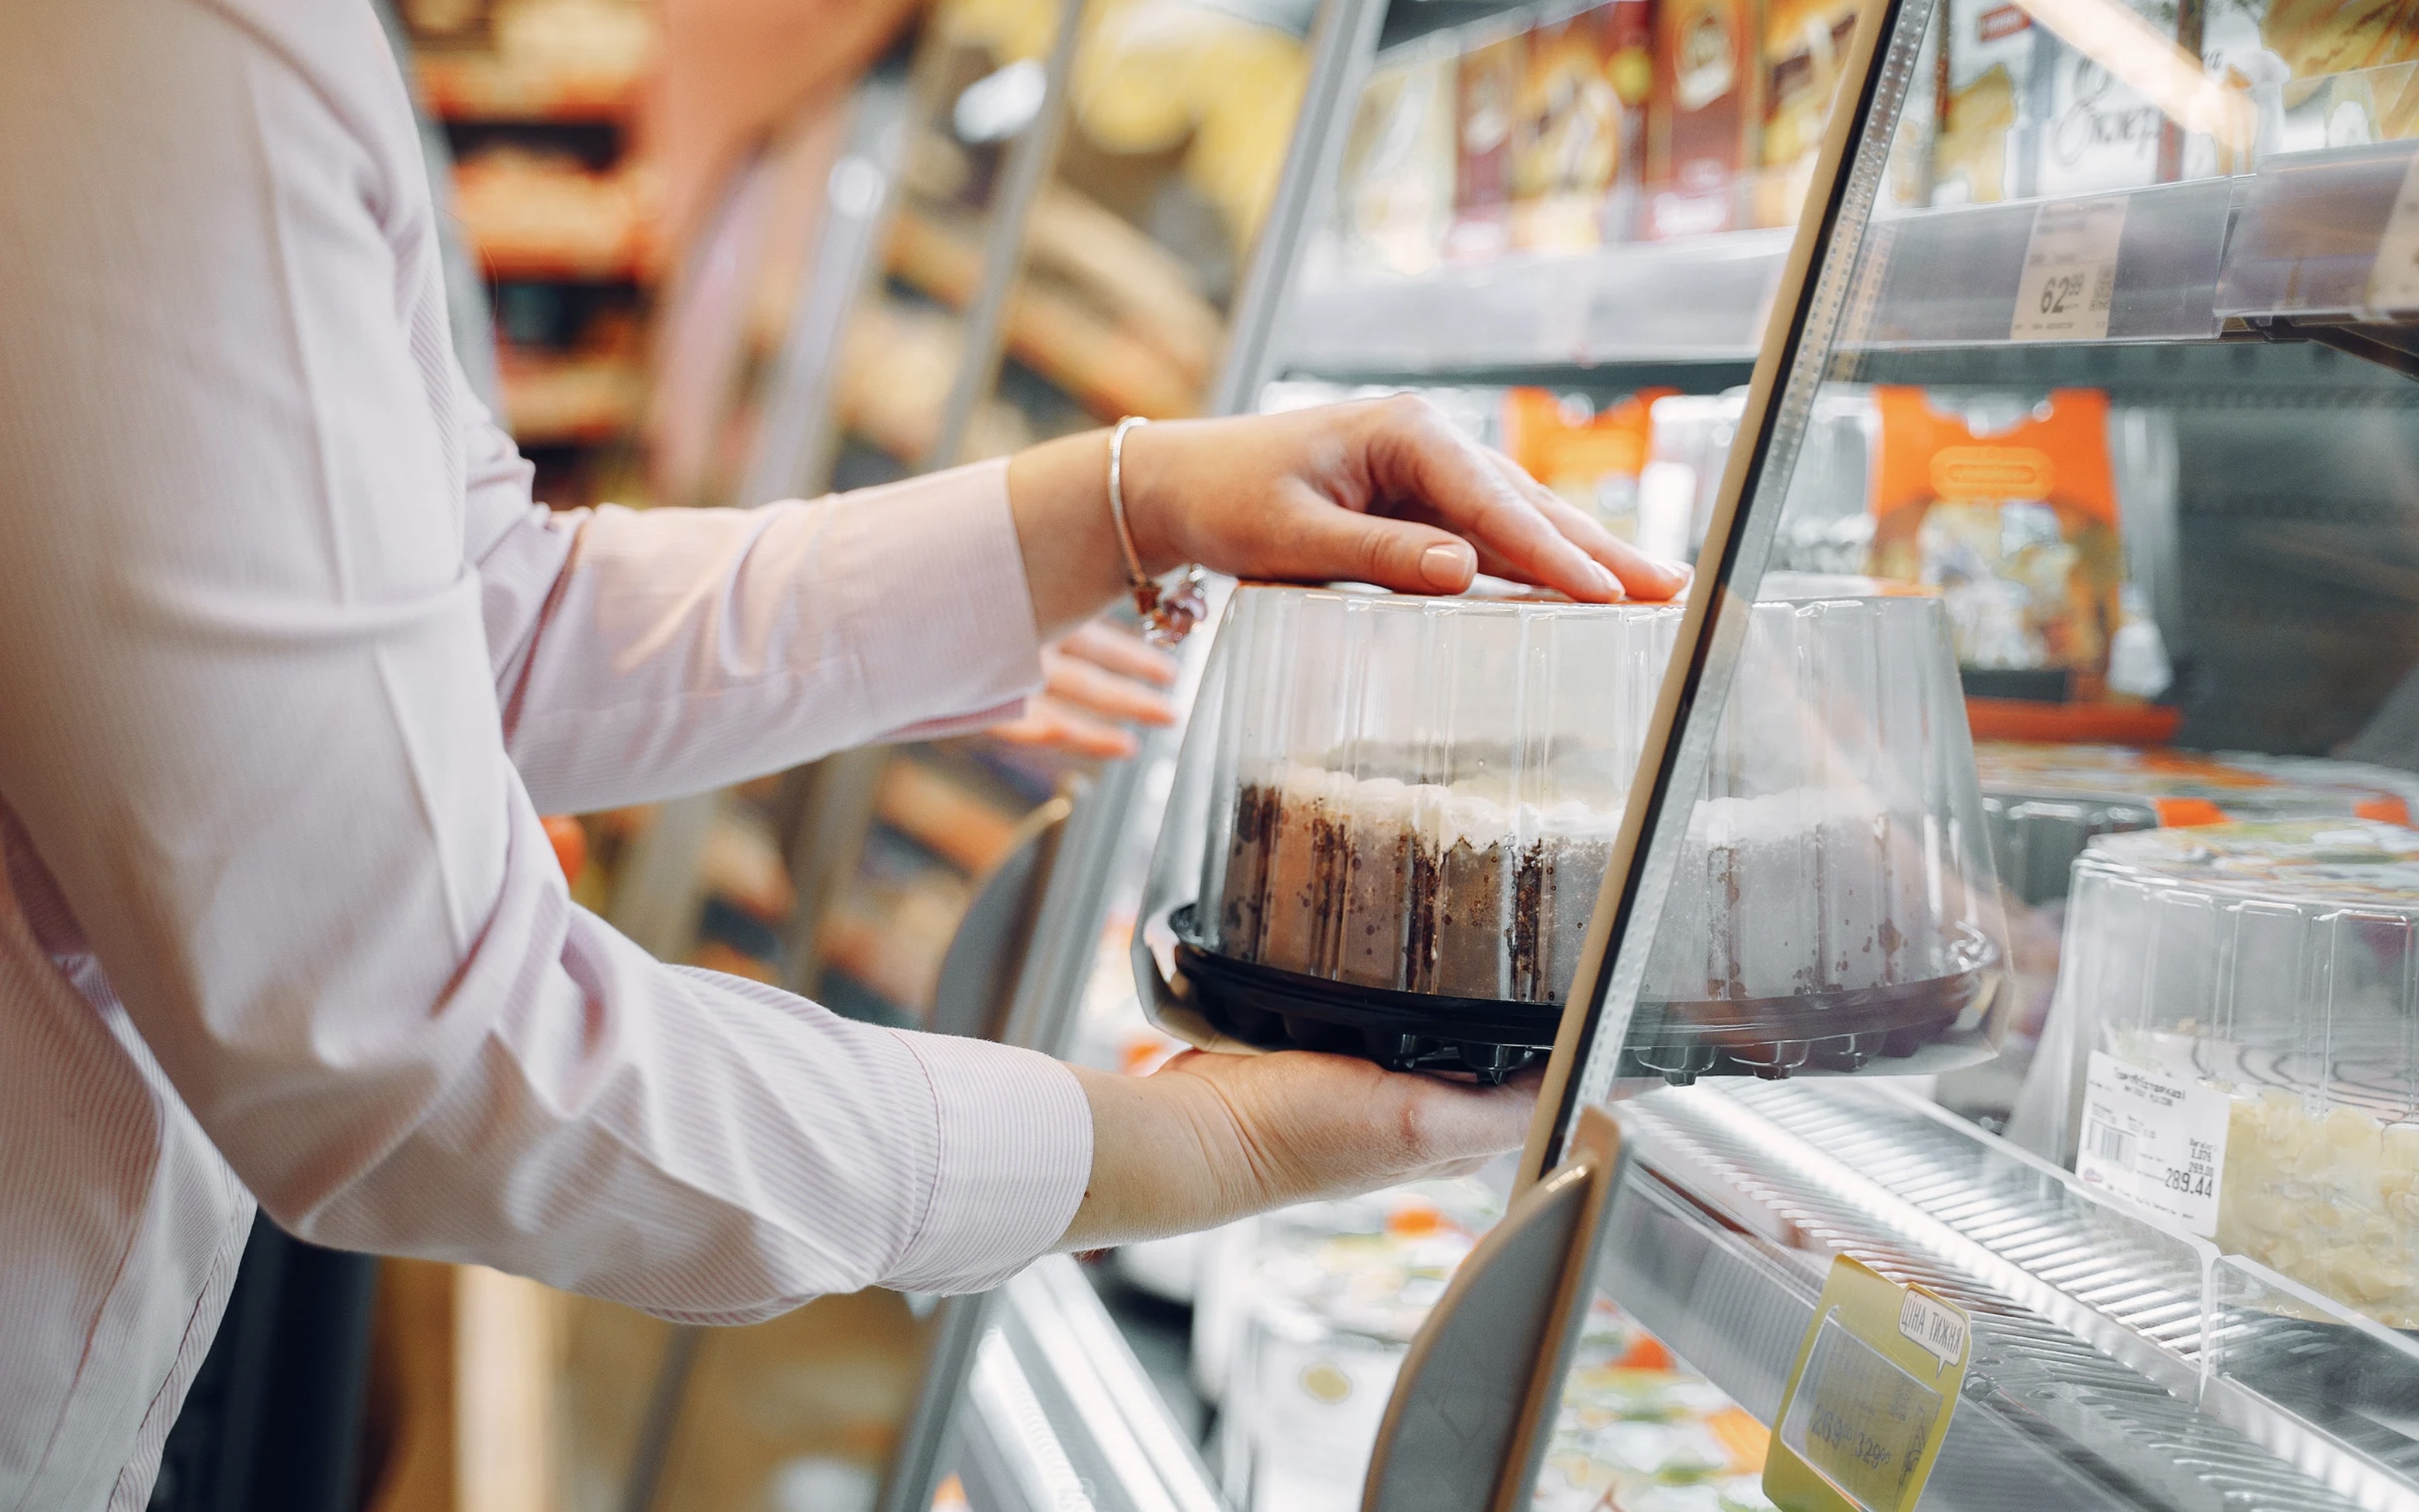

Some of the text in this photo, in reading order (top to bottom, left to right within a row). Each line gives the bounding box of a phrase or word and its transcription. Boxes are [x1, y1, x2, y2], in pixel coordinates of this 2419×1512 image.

[2164, 1167, 2213, 1199] 289.44
[1901, 1294, 1963, 1356] ЦІНА ТИЖНЯ
